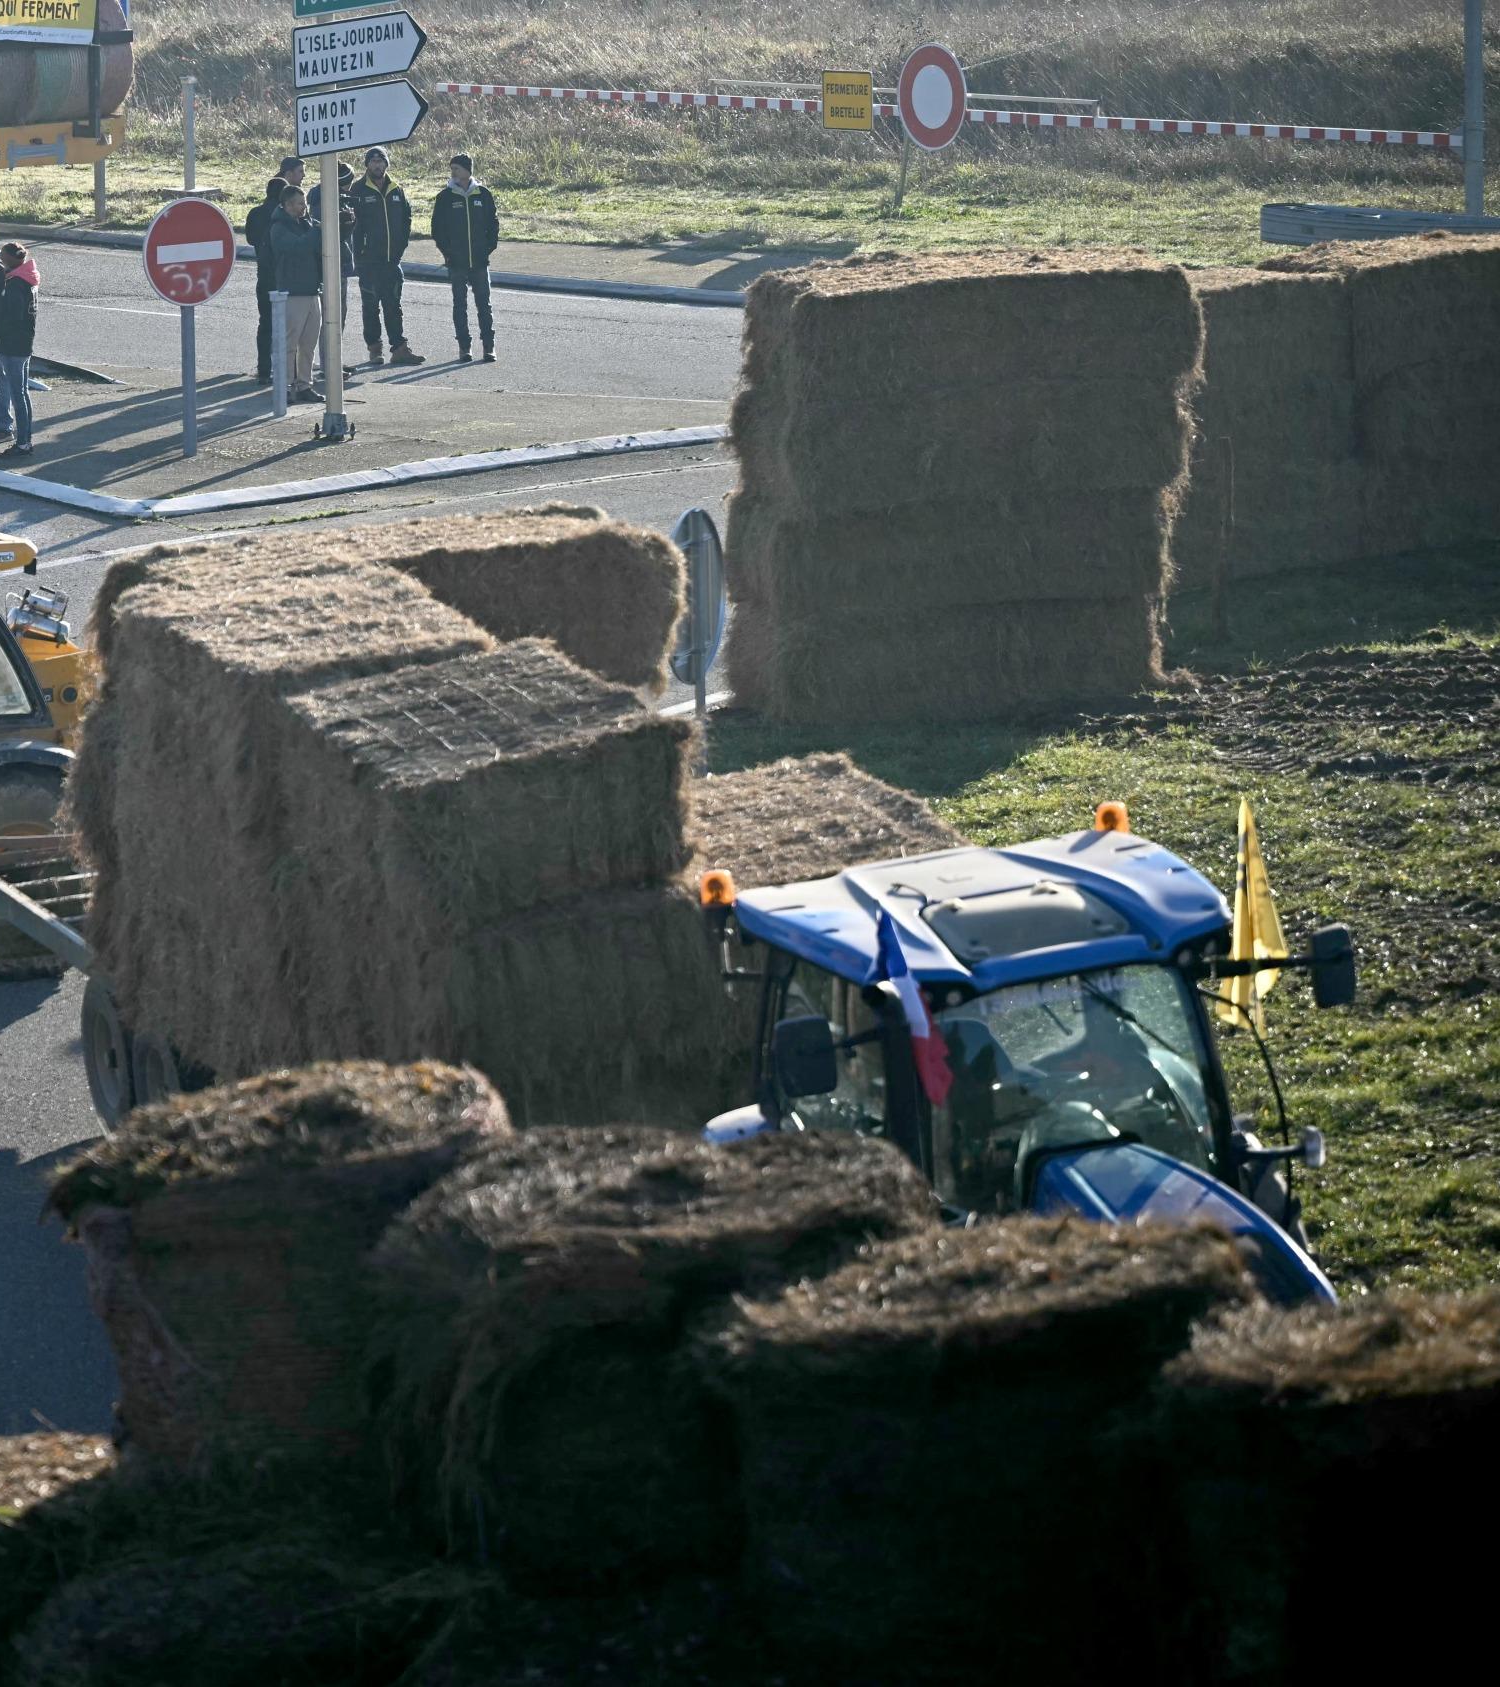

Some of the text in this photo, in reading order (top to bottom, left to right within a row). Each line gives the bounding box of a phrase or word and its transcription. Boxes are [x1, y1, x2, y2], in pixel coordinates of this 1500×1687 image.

[21, 0, 80, 20] FERMENT
[298, 22, 404, 54] L'ISLE-JOURDAIN
[299, 50, 374, 78] MAUVEZIN
[826, 83, 869, 96] FERMETURE
[301, 98, 357, 123] GIMONT
[830, 106, 865, 119] BRETELLE
[302, 122, 354, 147] AUBIET
